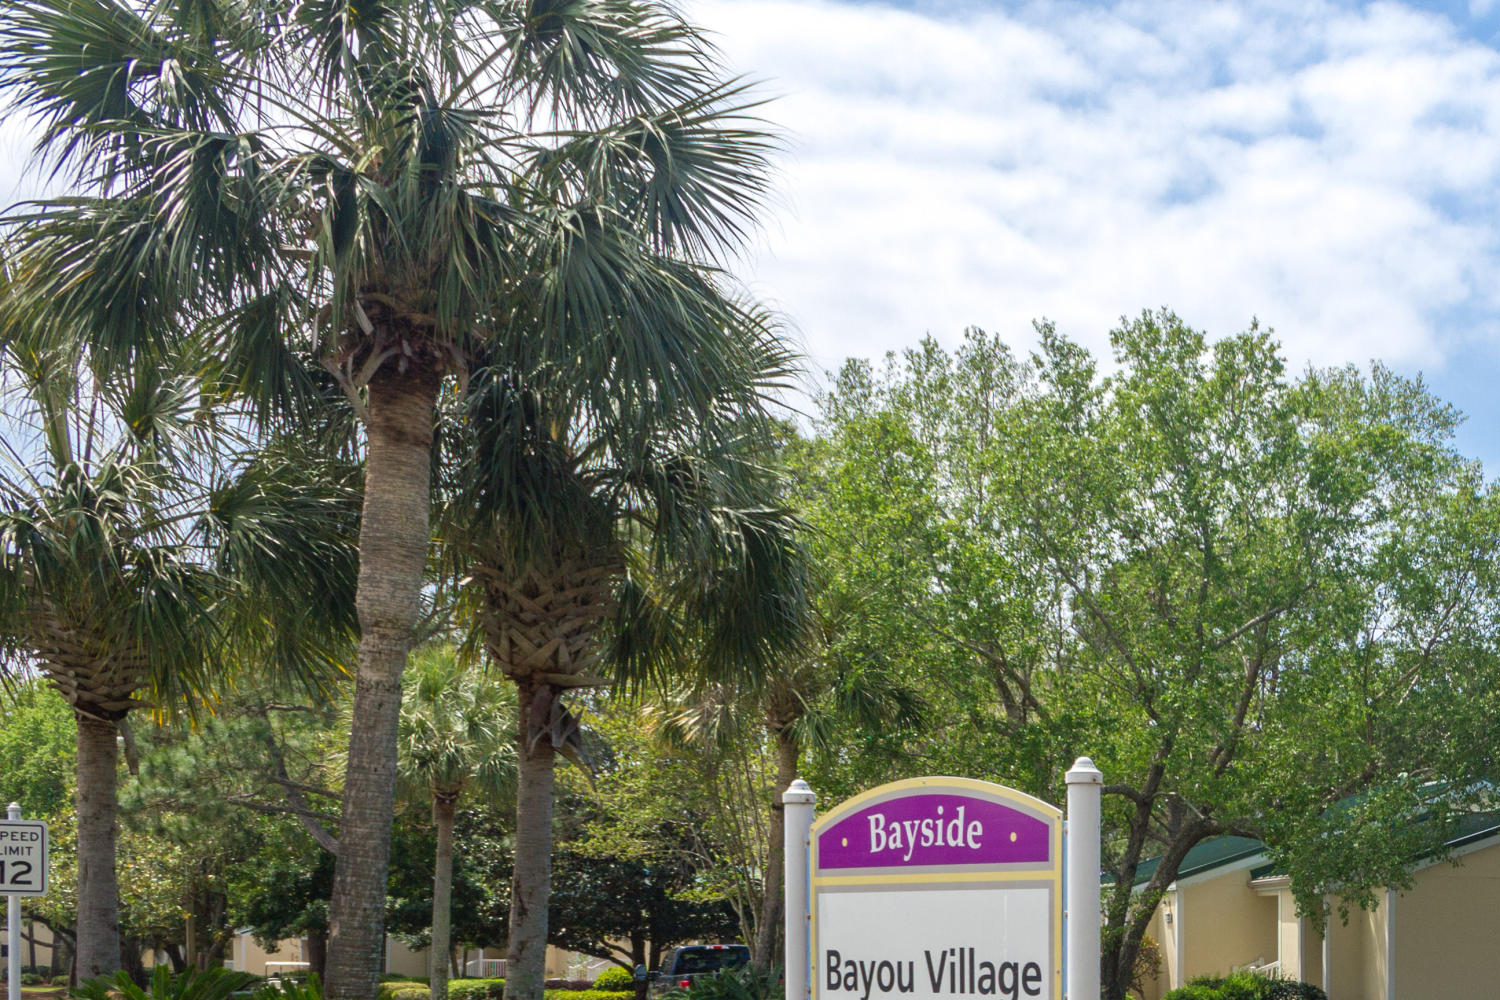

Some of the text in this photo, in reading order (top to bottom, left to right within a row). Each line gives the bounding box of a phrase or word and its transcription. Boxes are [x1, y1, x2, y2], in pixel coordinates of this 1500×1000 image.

[0, 830, 39, 842] PEED
[867, 806, 983, 862] Bayside
[0, 845, 34, 857] IMIT
[0, 860, 33, 886] 12
